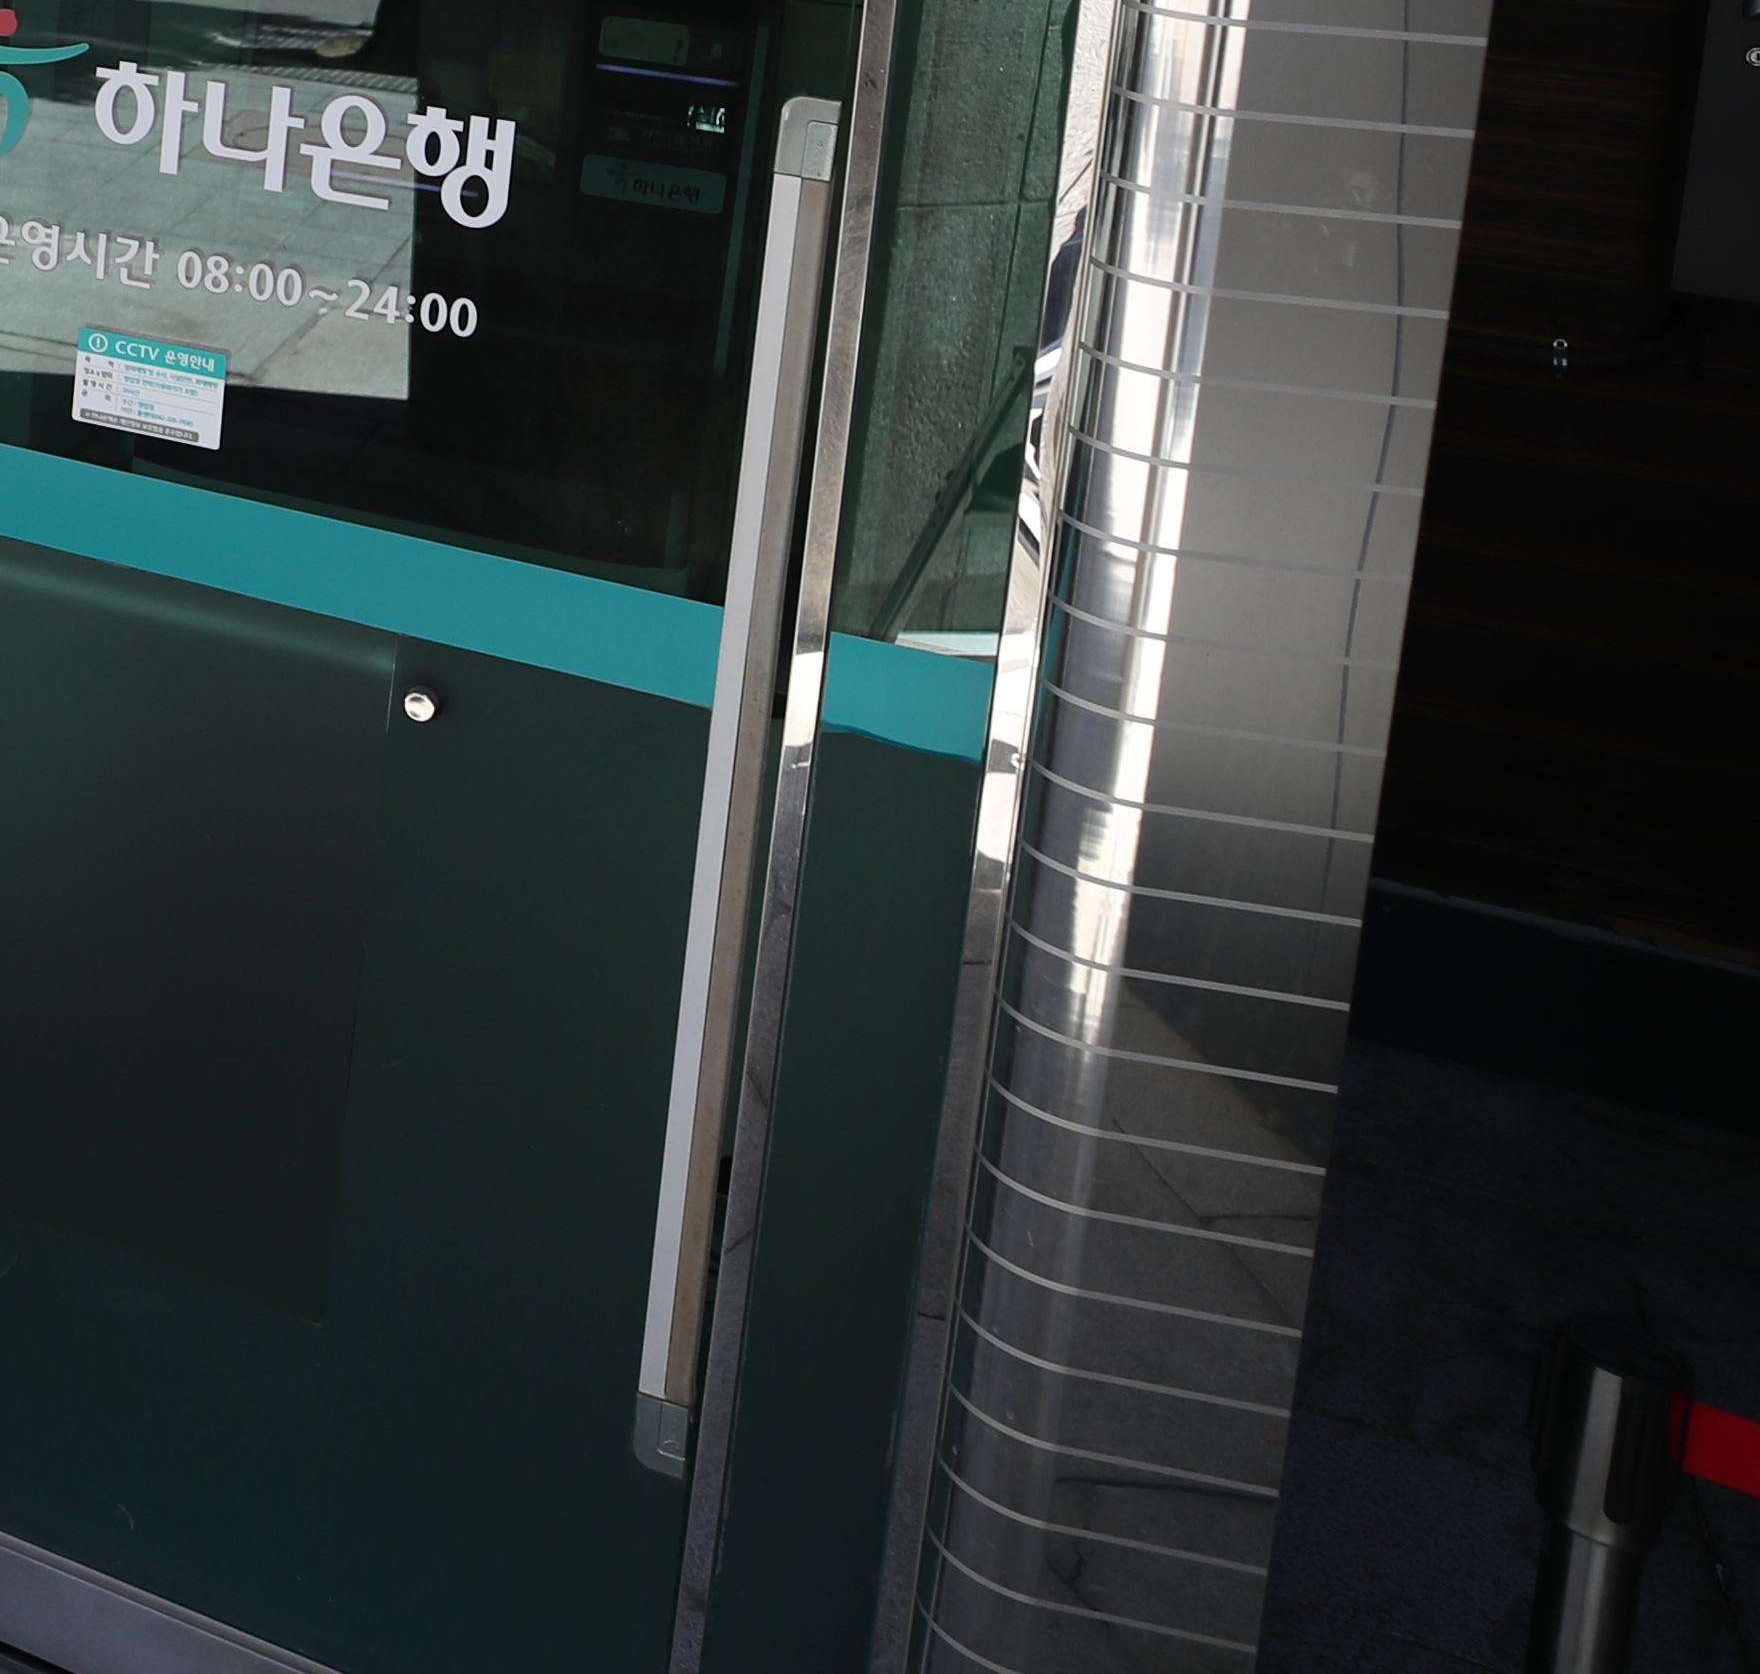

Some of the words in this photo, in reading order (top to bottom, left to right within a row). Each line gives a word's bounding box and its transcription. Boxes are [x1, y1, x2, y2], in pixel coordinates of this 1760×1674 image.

[94, 60, 517, 229] 하나은행
[176, 248, 479, 339] 08:00~24:00
[114, 339, 161, 361] CCTV
[164, 349, 216, 373] 운영안내
